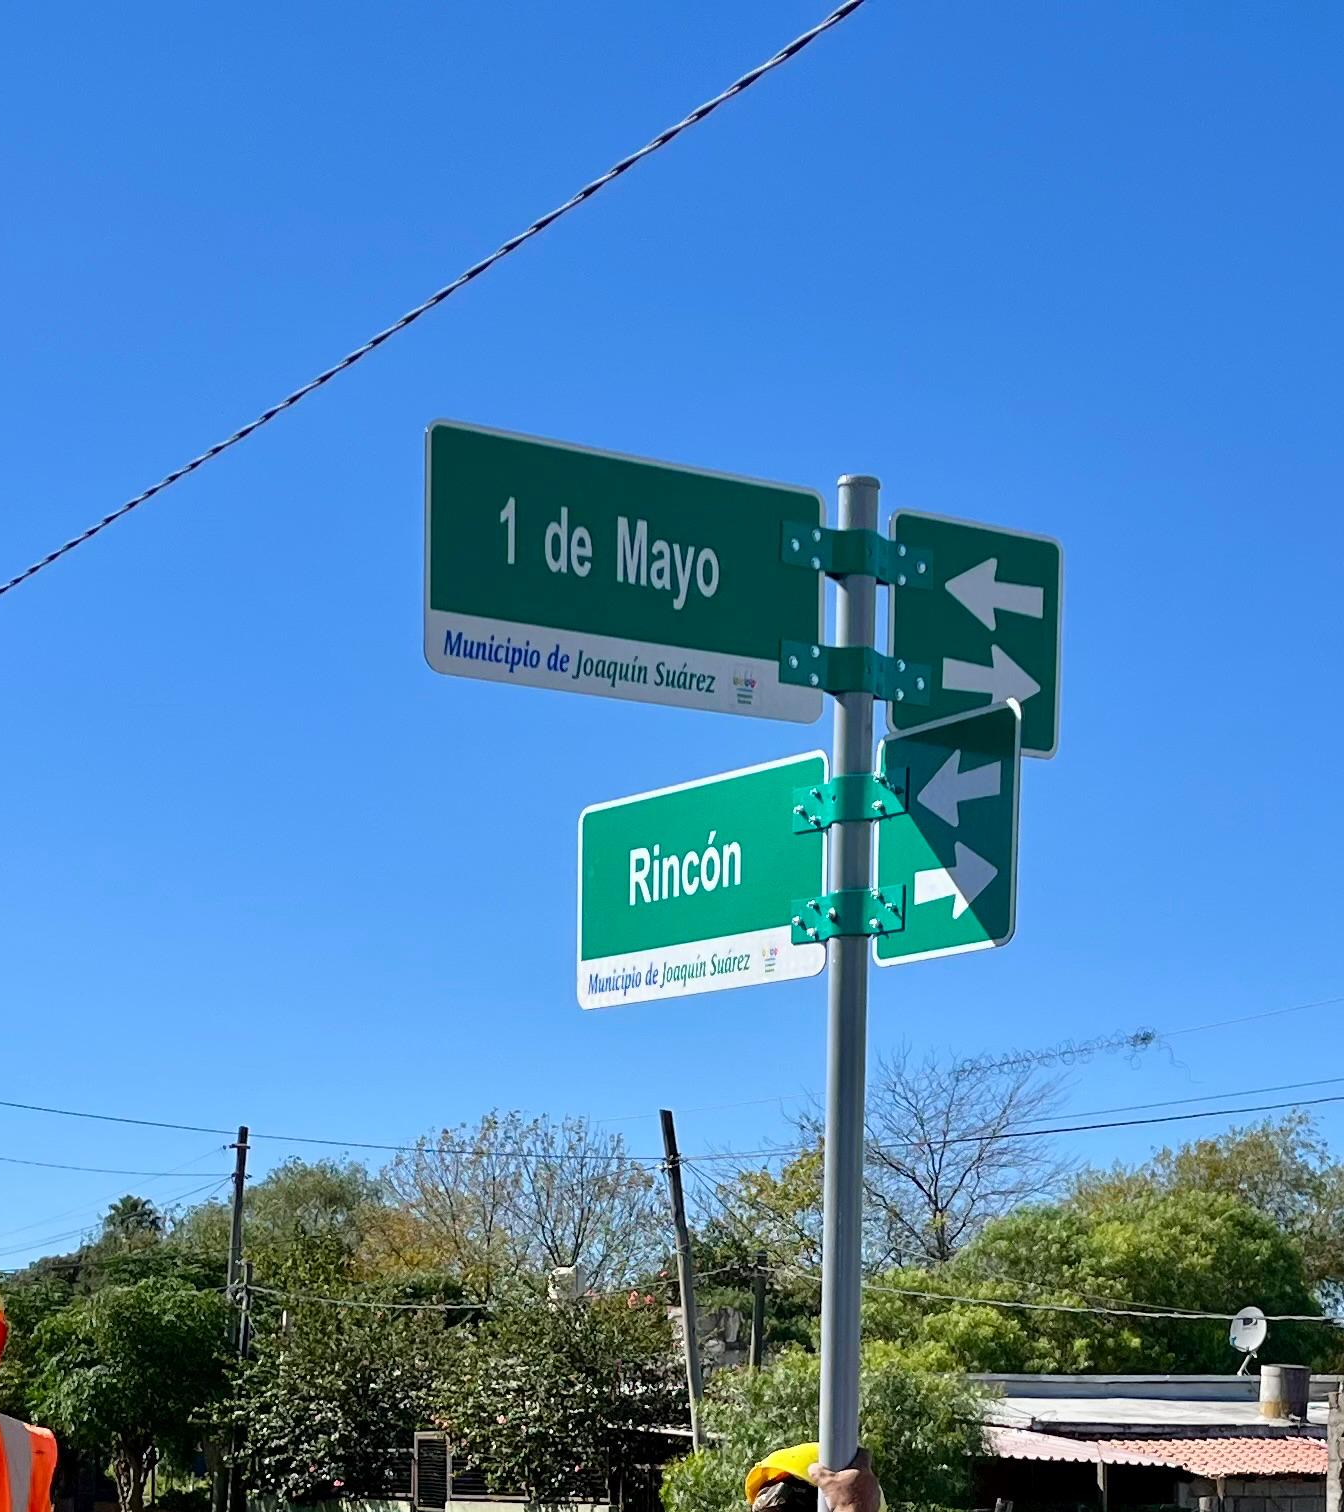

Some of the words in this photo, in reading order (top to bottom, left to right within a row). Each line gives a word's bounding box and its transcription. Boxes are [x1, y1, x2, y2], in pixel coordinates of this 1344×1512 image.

[499, 496, 516, 565] 1
[545, 506, 593, 577] de
[617, 516, 720, 610] Mayo
[444, 629, 541, 674] Municipio
[547, 643, 570, 673] de
[571, 649, 649, 688] Joaquín
[654, 661, 716, 693] Suárez
[629, 830, 742, 906] Rincón
[588, 965, 642, 996] Municipio
[645, 961, 659, 986] de
[659, 954, 707, 988] Joaquín
[710, 948, 751, 977] Suárez
